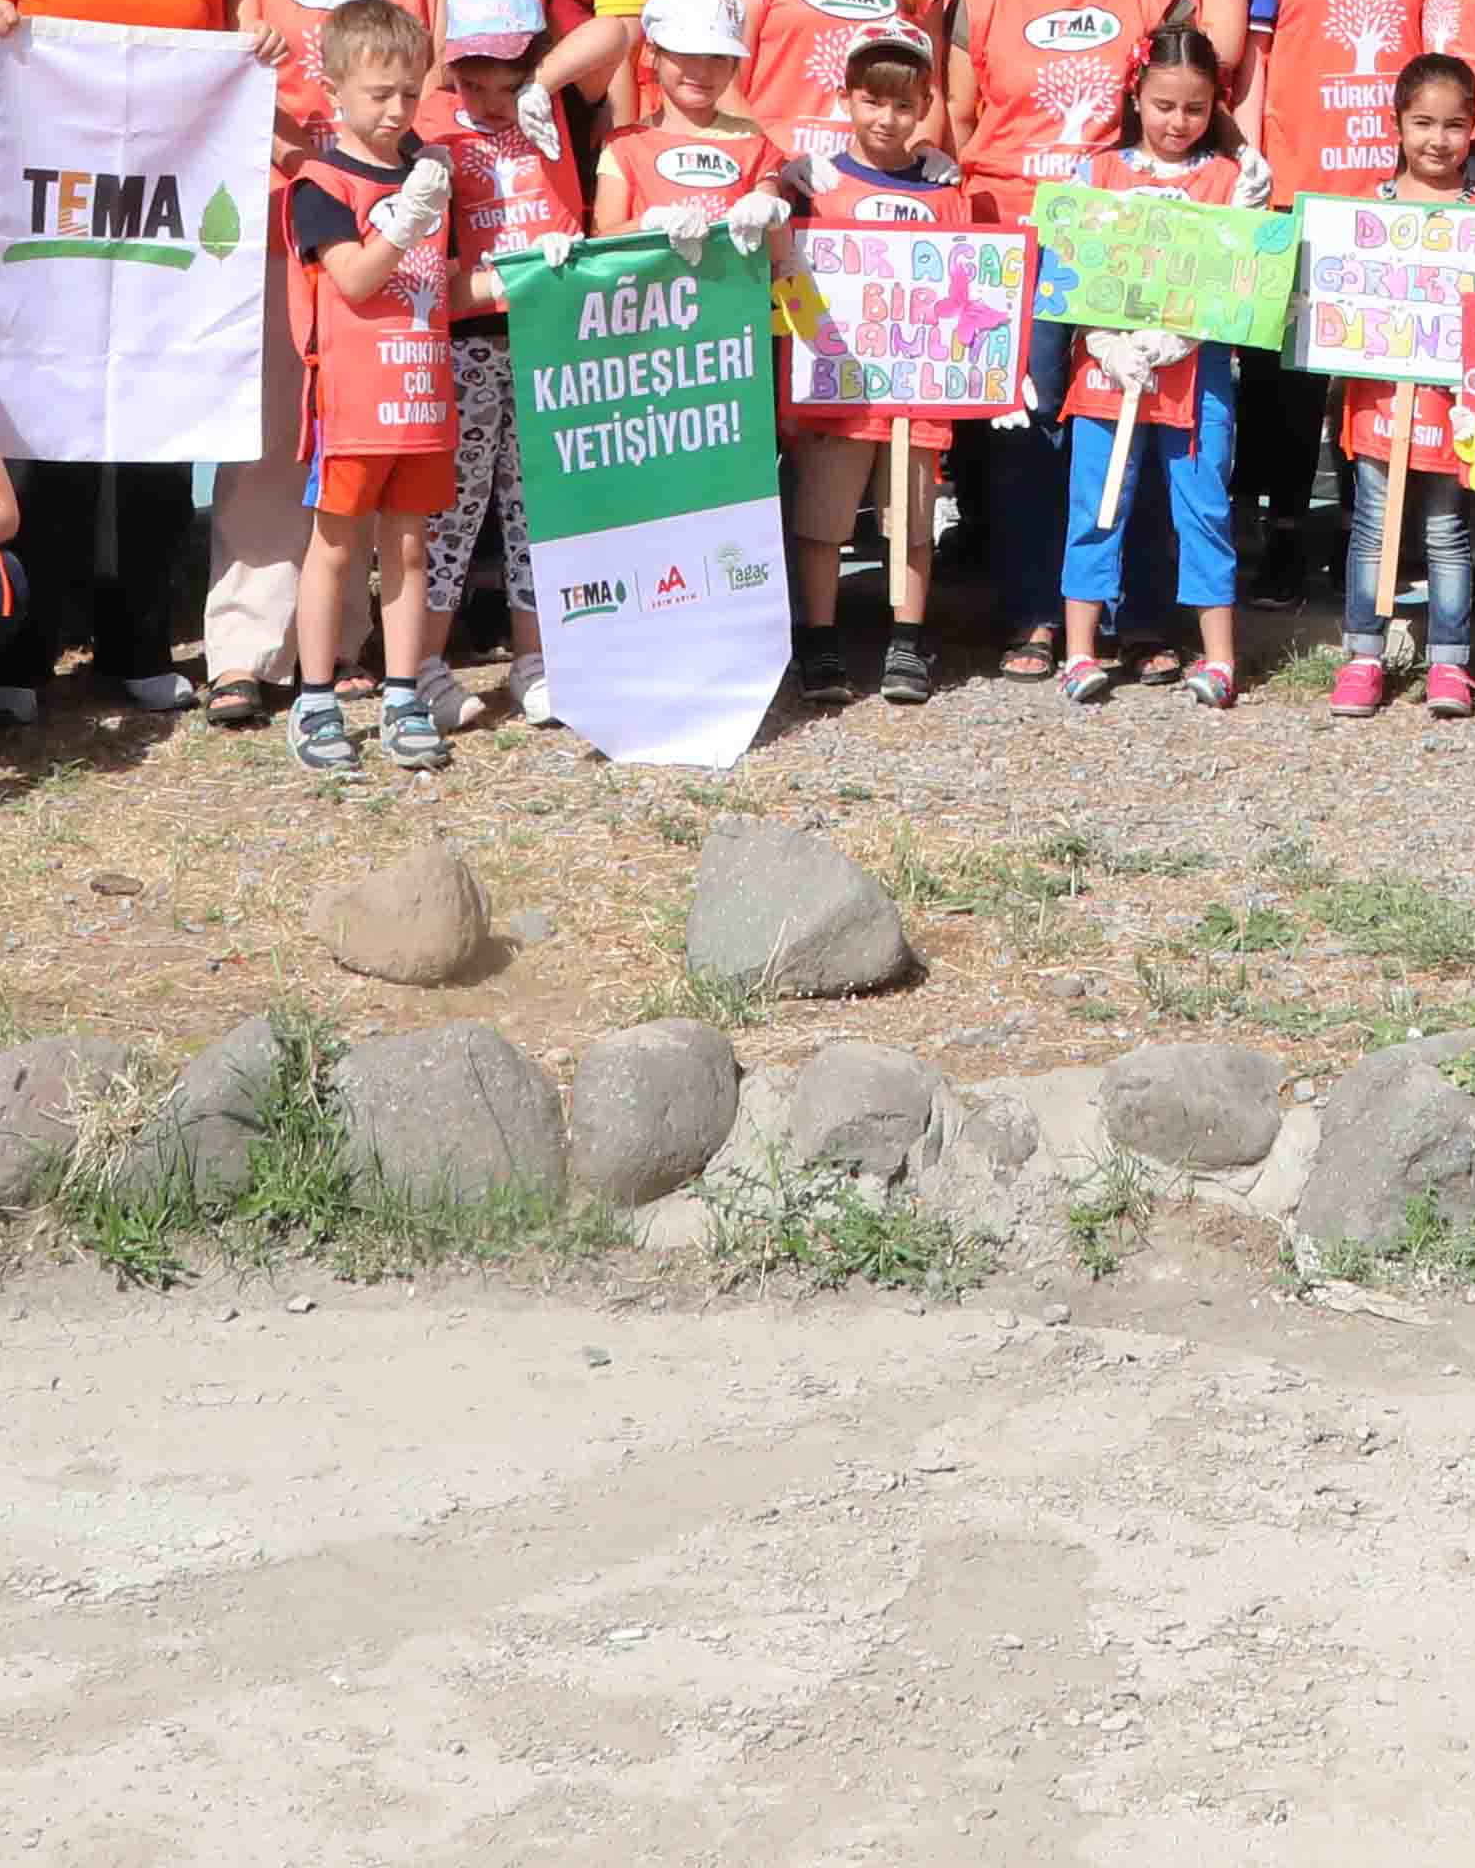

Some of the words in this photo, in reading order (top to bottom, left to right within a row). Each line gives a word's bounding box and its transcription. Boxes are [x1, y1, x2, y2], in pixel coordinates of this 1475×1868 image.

[1047, 13, 1096, 39] TEMA
[1319, 80, 1396, 109] TÜRKİY
[793, 127, 856, 154] TÜRK
[1346, 111, 1388, 145] ÇÖL
[676, 152, 723, 171] TEMA
[1321, 146, 1399, 170] OLMASI
[23, 168, 185, 239] TEMA
[469, 195, 550, 230] TÜRKİYE
[875, 201, 919, 222] TEMA
[578, 276, 699, 341] AĞAÇ
[404, 365, 435, 400] ÇÖL
[533, 324, 754, 414] KARDEŞLERİ
[554, 400, 742, 474] YETİŞİYOR!
[560, 580, 613, 611] TEMA
